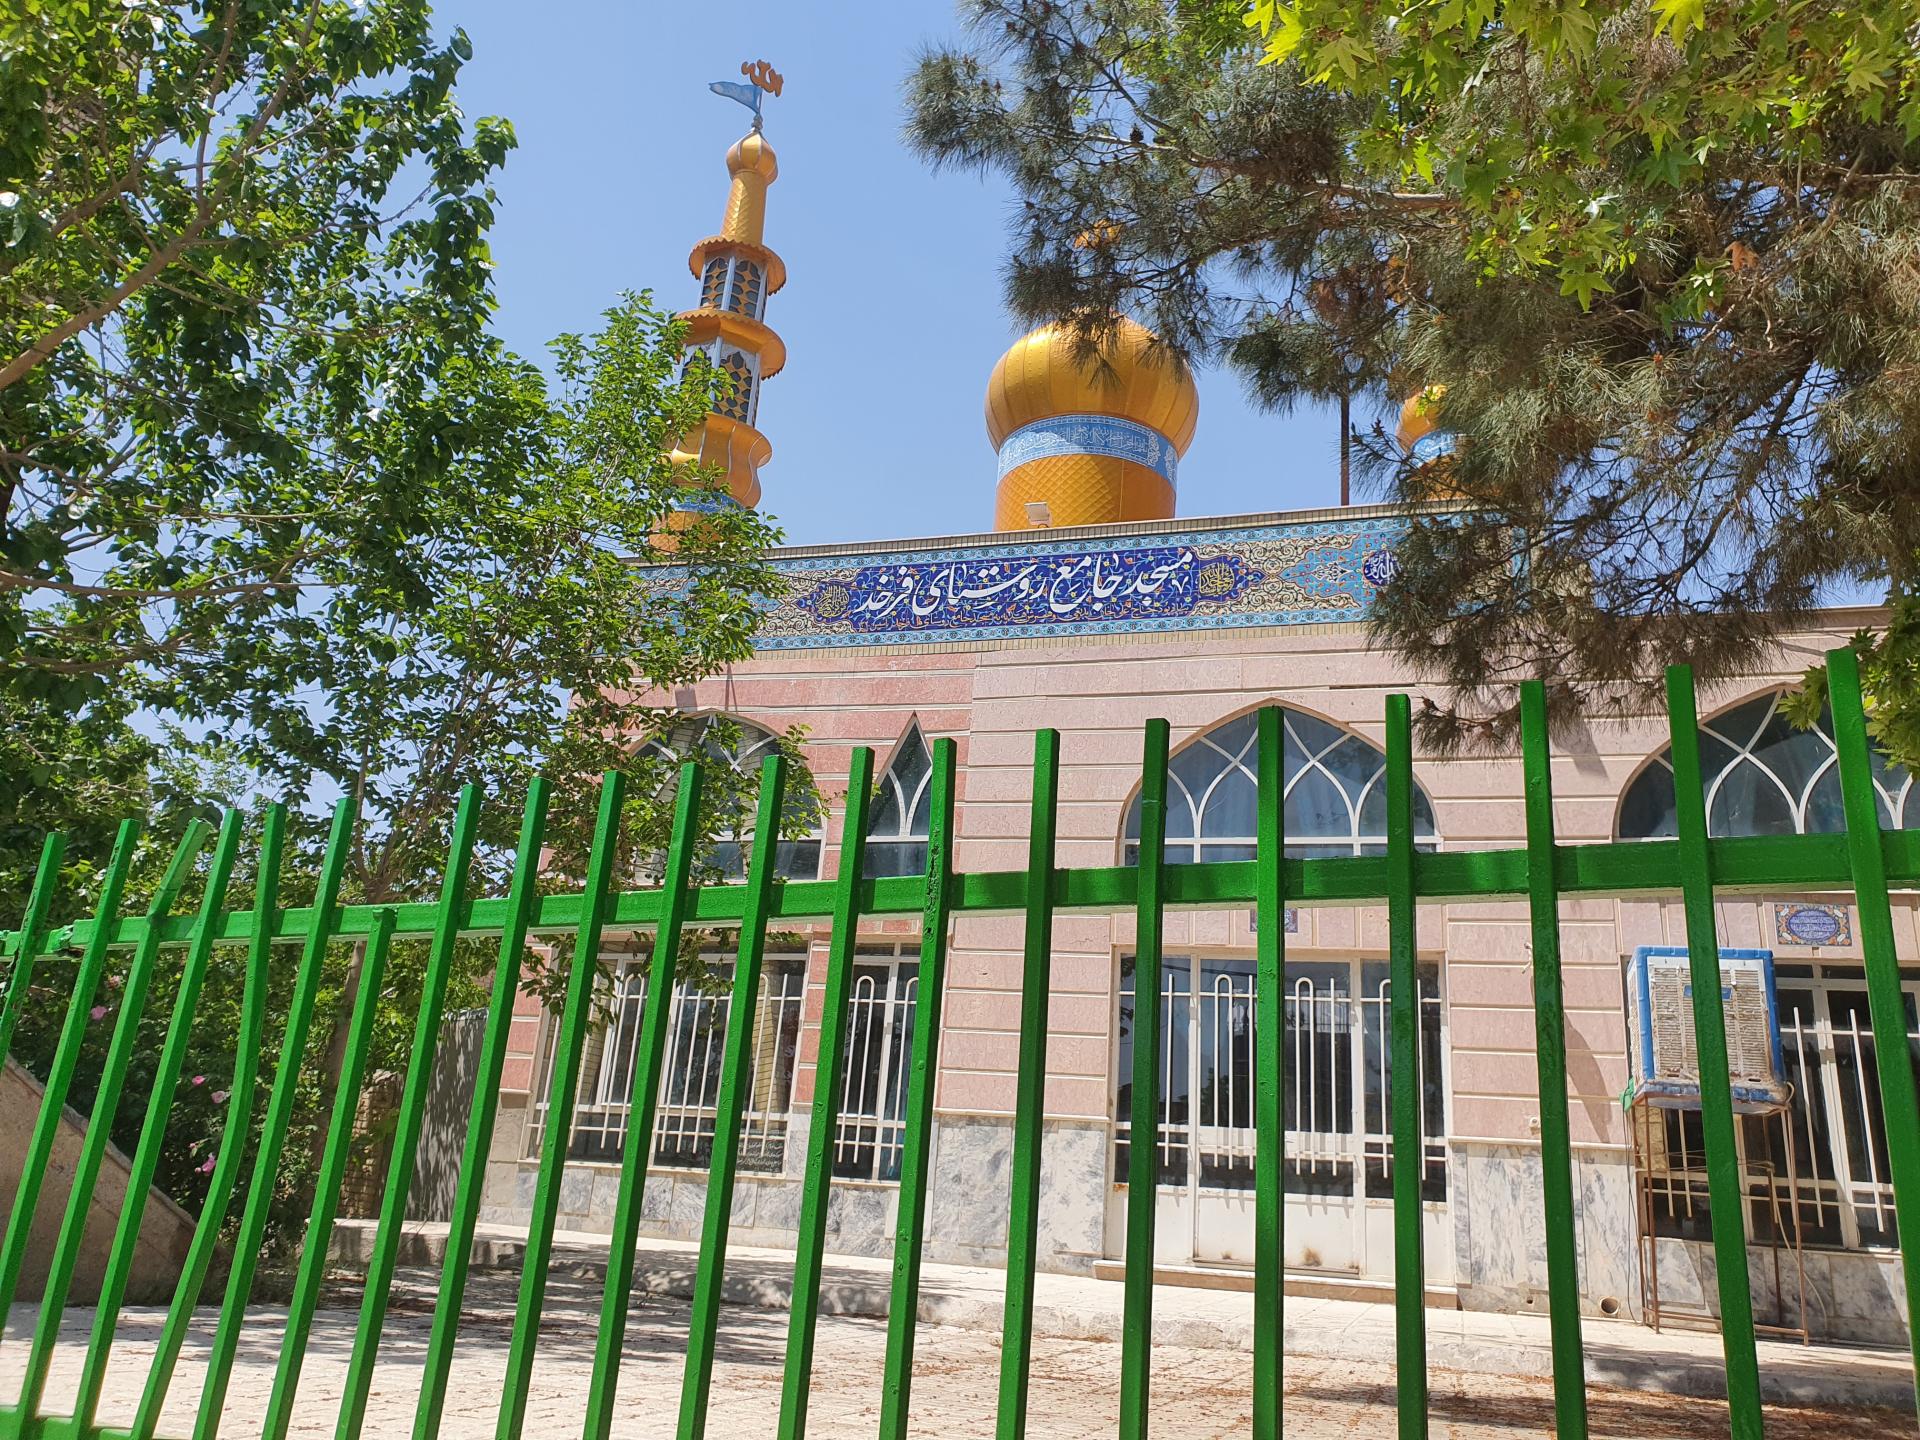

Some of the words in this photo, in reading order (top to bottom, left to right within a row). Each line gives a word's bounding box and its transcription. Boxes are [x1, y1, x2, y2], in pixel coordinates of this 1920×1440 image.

[854, 565, 913, 619] فرخد
[911, 562, 1048, 616] روستای
[1050, 552, 1124, 614] جامع
[1121, 550, 1193, 605] مسجد
